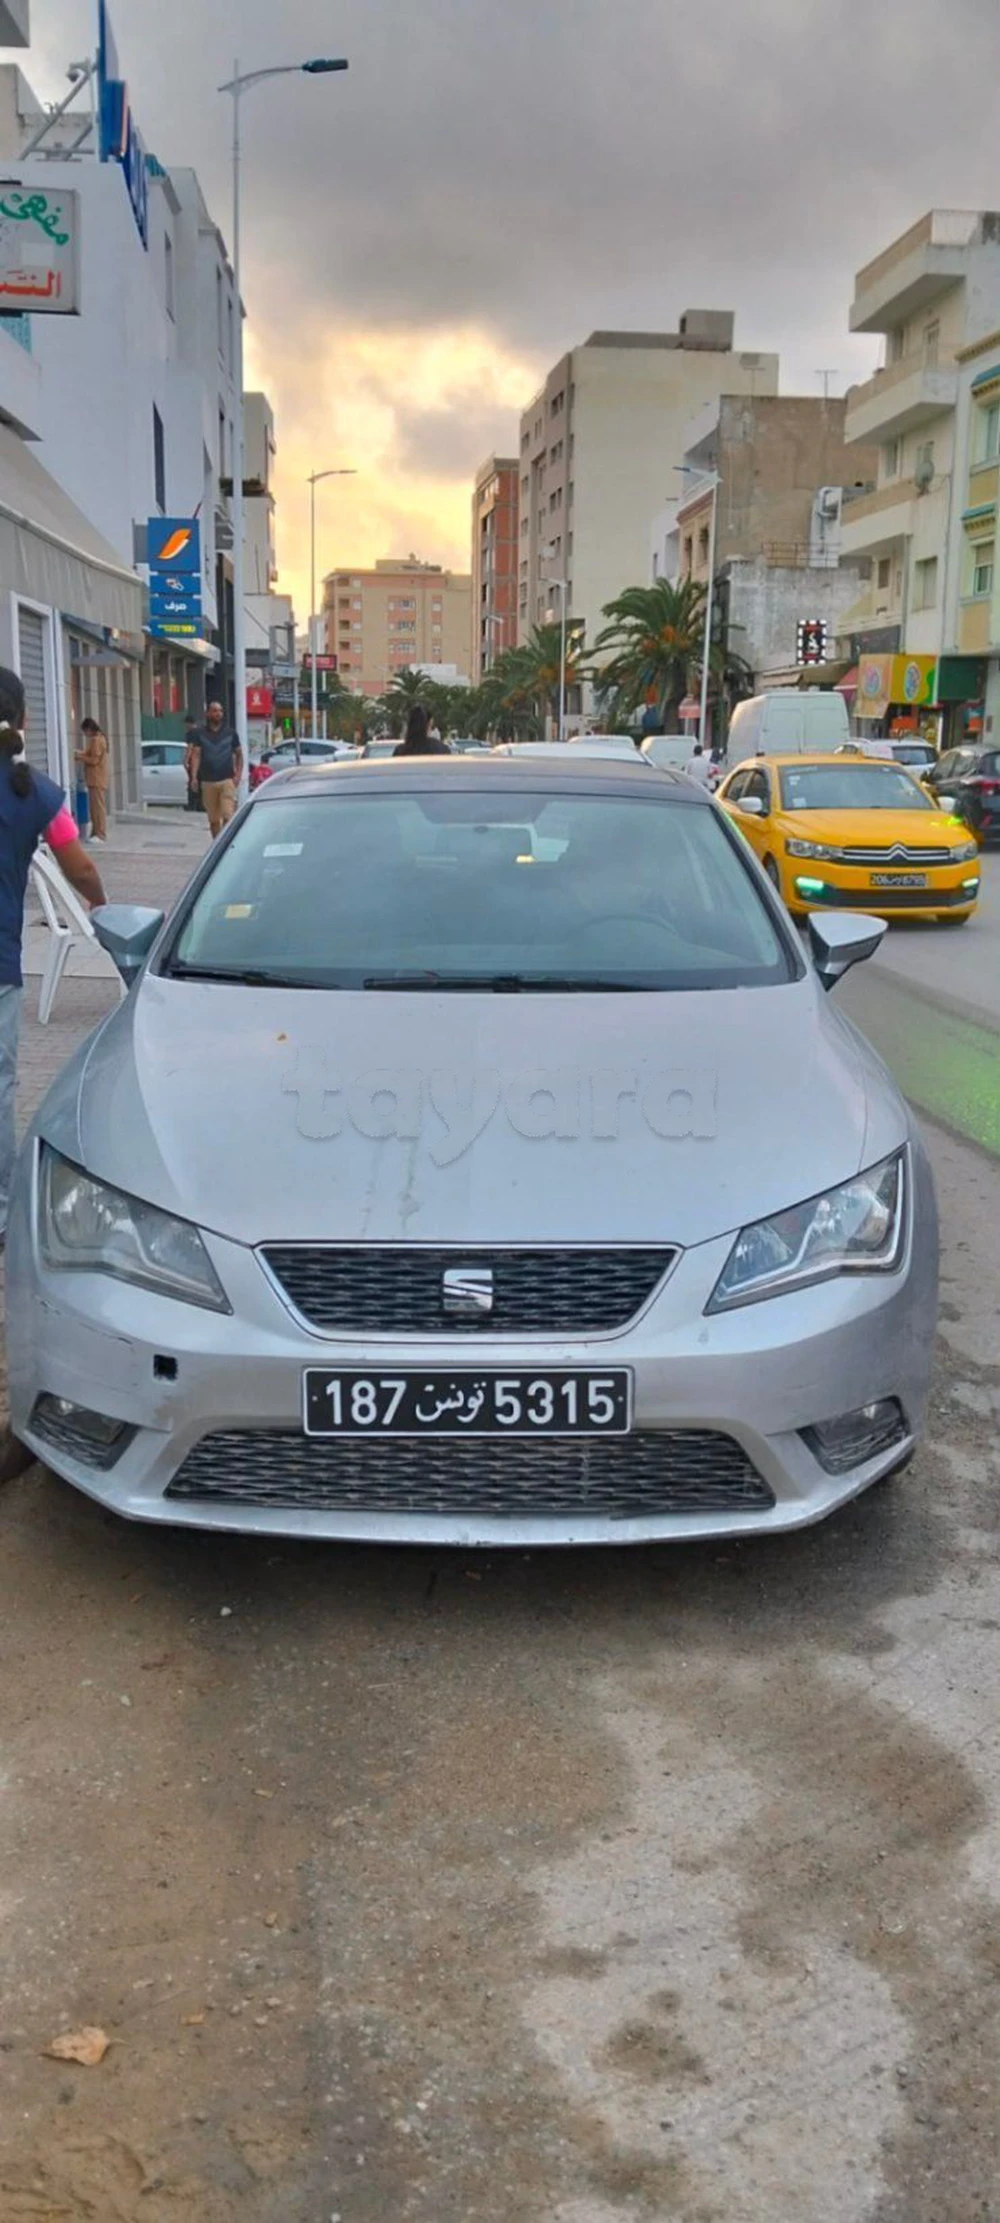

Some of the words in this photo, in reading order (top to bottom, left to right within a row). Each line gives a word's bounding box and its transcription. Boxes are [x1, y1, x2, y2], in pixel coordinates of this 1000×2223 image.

[325, 1379, 407, 1425] 187
[415, 1381, 487, 1423] تونس
[494, 1379, 616, 1425] 5315
